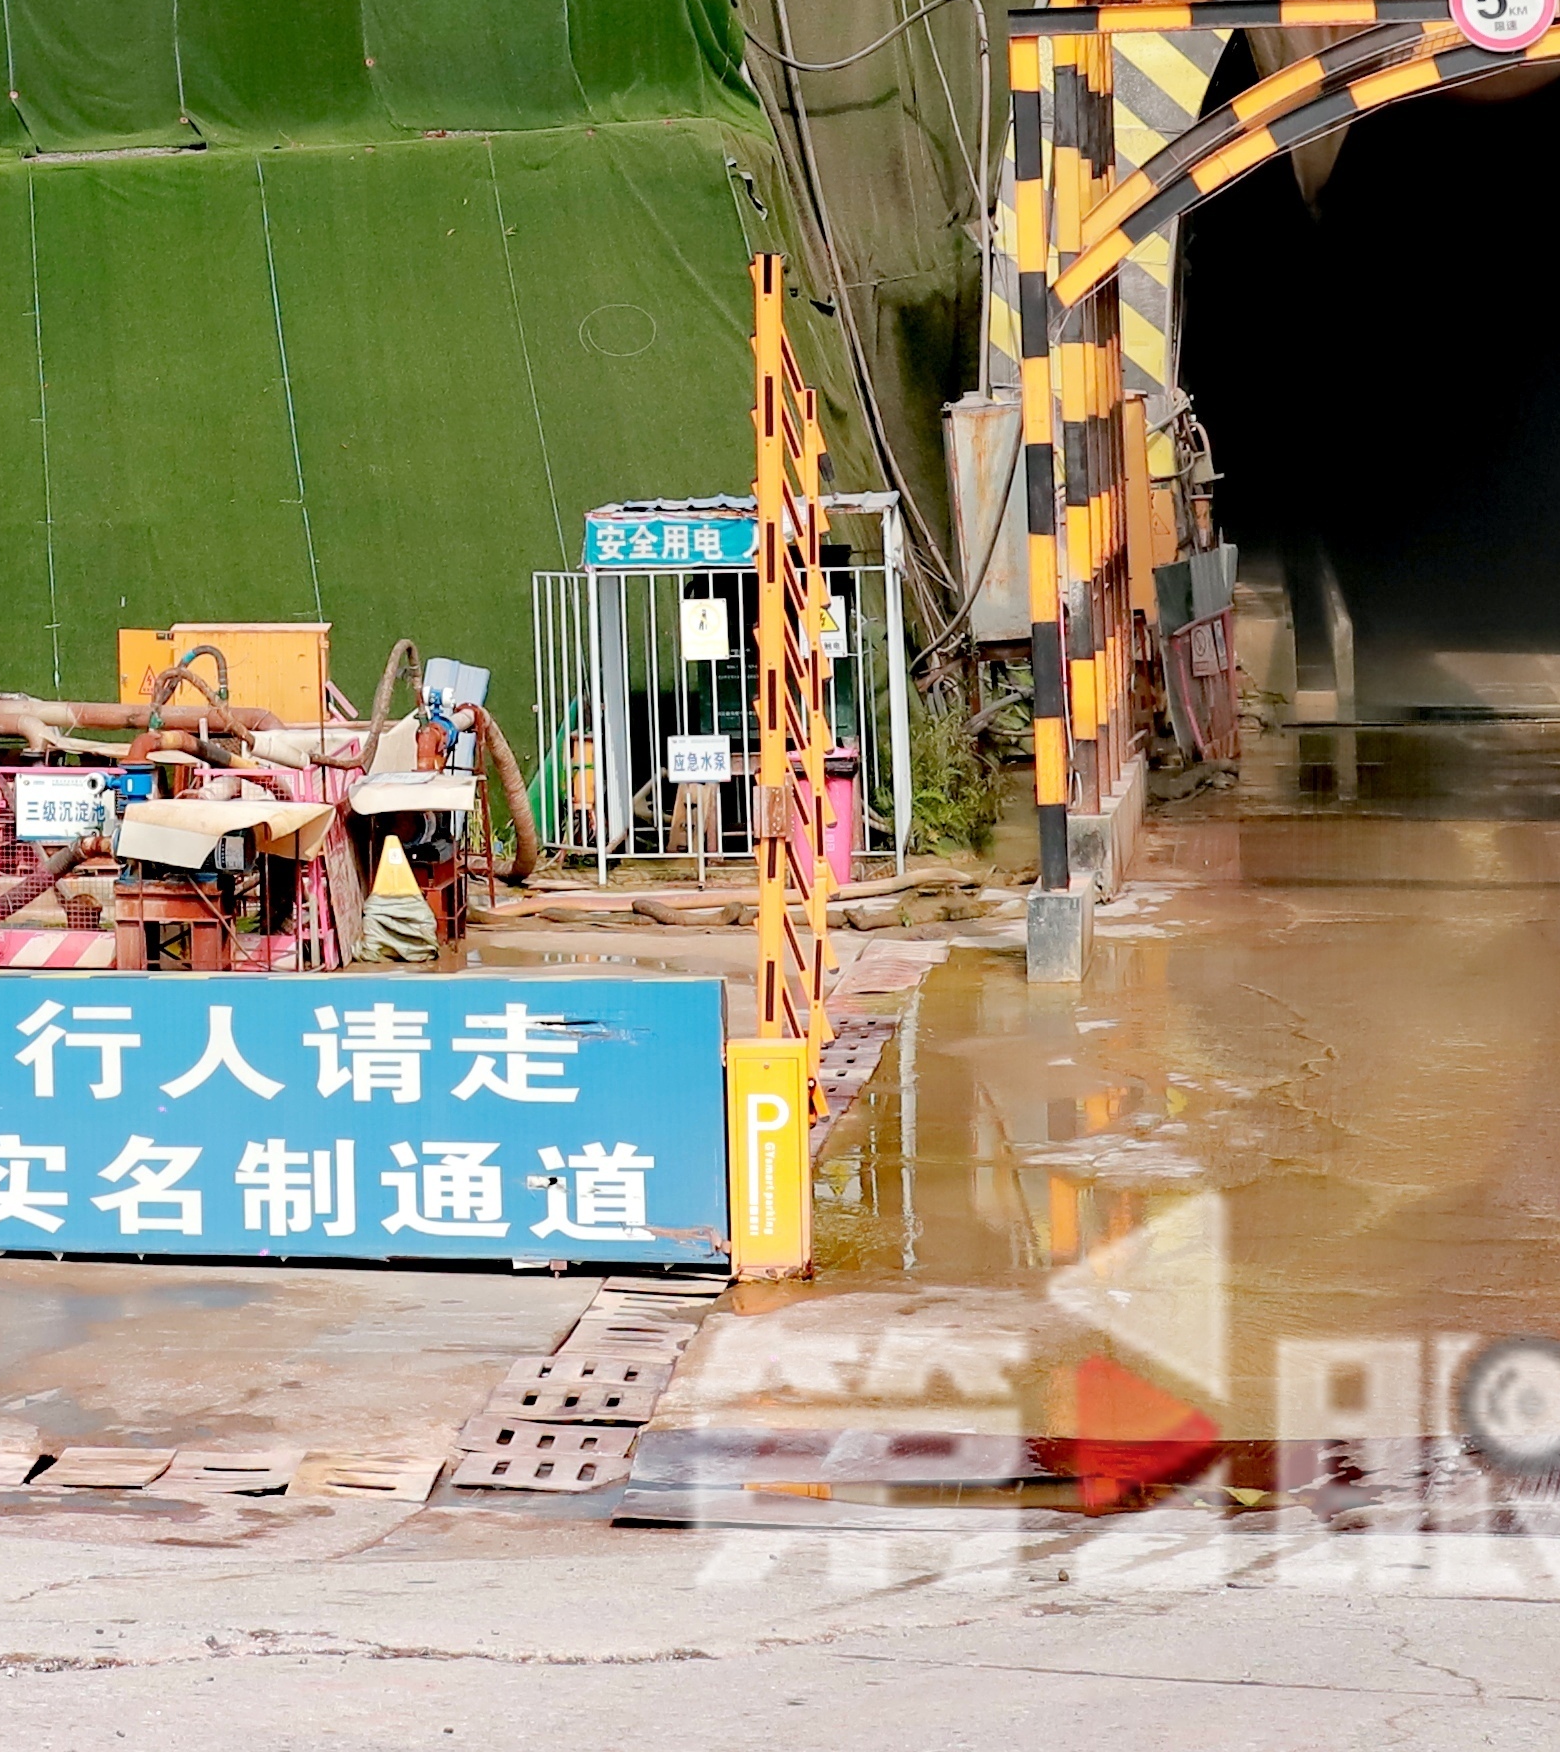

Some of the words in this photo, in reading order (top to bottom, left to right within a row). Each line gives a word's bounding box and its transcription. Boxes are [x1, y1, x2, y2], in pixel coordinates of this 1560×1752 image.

[1493, 19, 1518, 33] 限速
[596, 524, 723, 561] 安全用电
[673, 751, 727, 772] 应急水泵
[26, 799, 106, 822] 三级沉淀池
[14, 1000, 582, 1105] 行人请走
